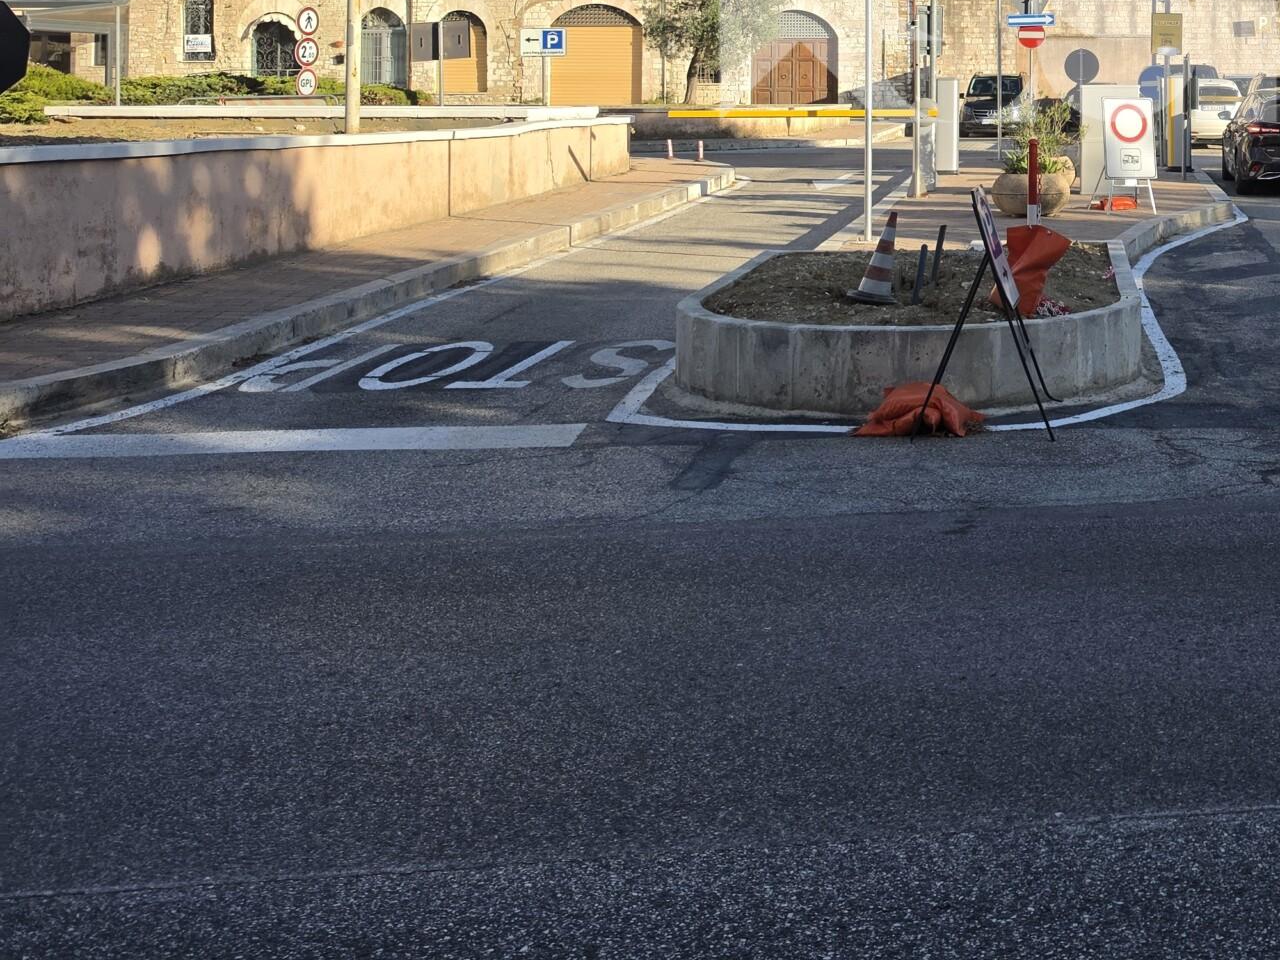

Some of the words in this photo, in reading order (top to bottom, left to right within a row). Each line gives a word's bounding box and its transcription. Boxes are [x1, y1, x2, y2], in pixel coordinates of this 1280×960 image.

[547, 34, 559, 49] P
[300, 78, 313, 88] GPL
[238, 339, 677, 392] STOP
